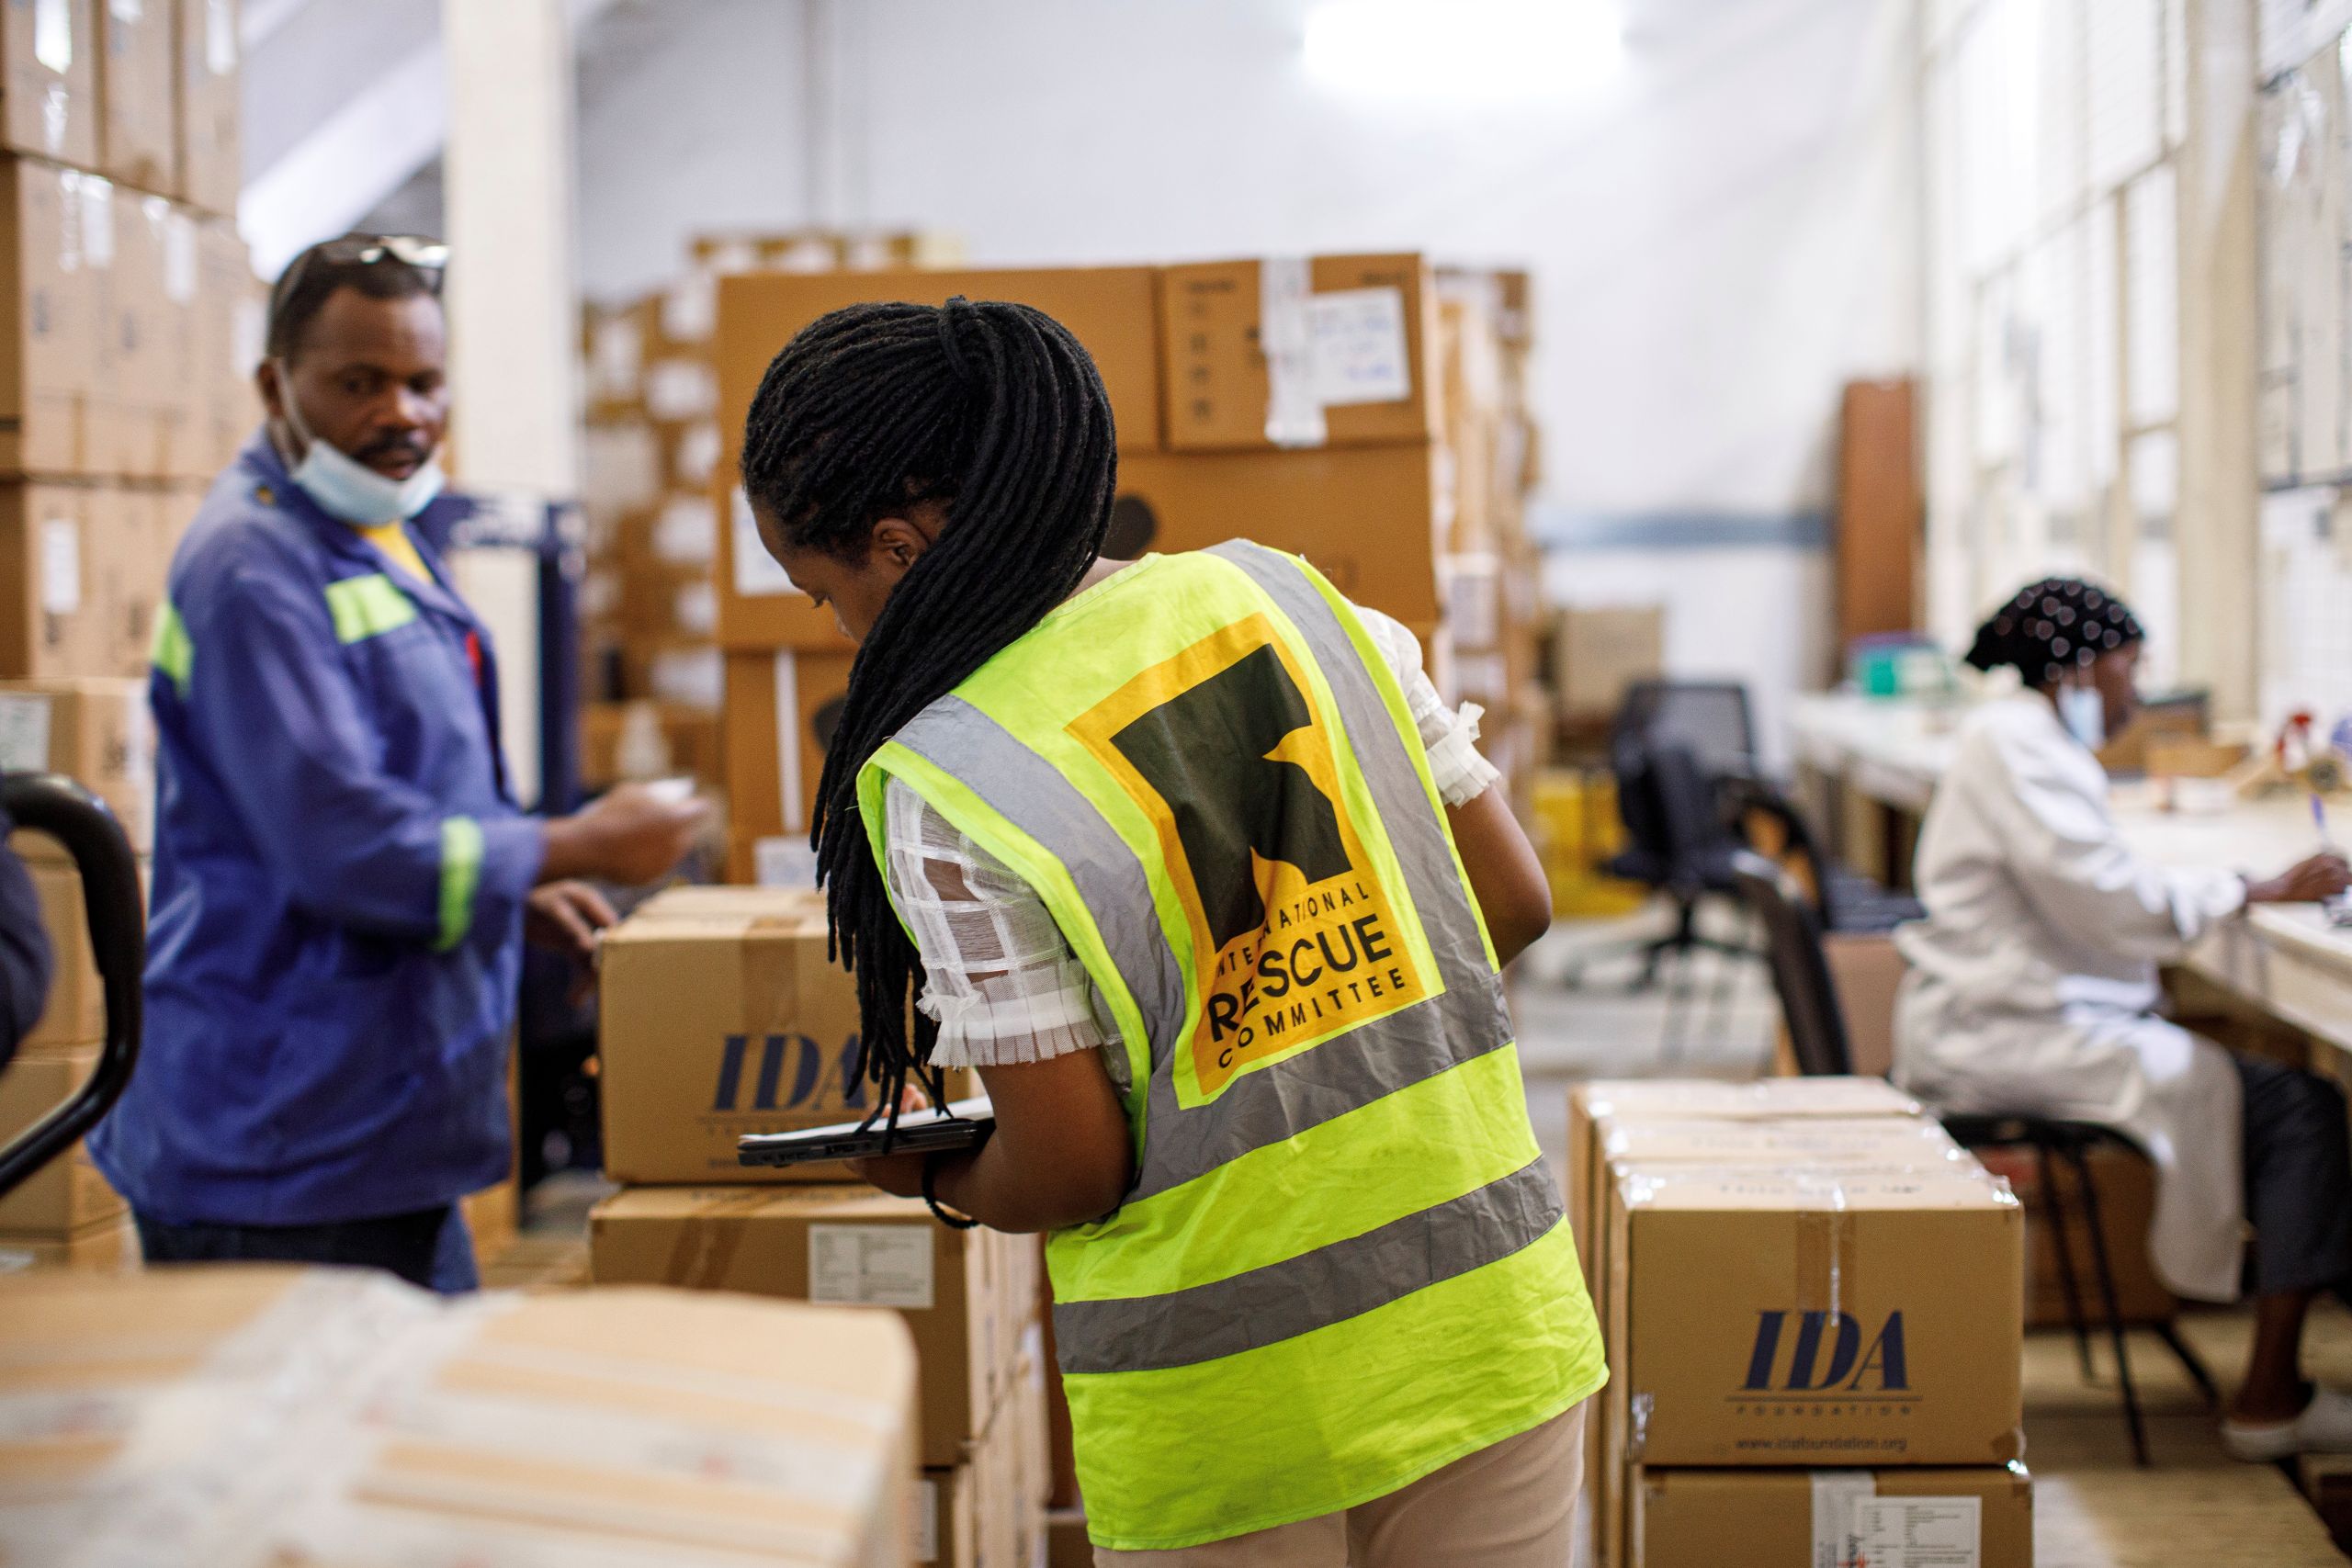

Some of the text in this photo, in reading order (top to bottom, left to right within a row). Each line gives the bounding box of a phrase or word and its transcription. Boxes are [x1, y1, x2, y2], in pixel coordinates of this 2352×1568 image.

[1207, 913, 1393, 1043] RESCUE
[1216, 882, 1369, 978] NTENATIONAL
[1217, 967, 1406, 1069] COMMITTEE
[711, 1032, 867, 1111] IDA
[1736, 1310, 1910, 1391] IDA
